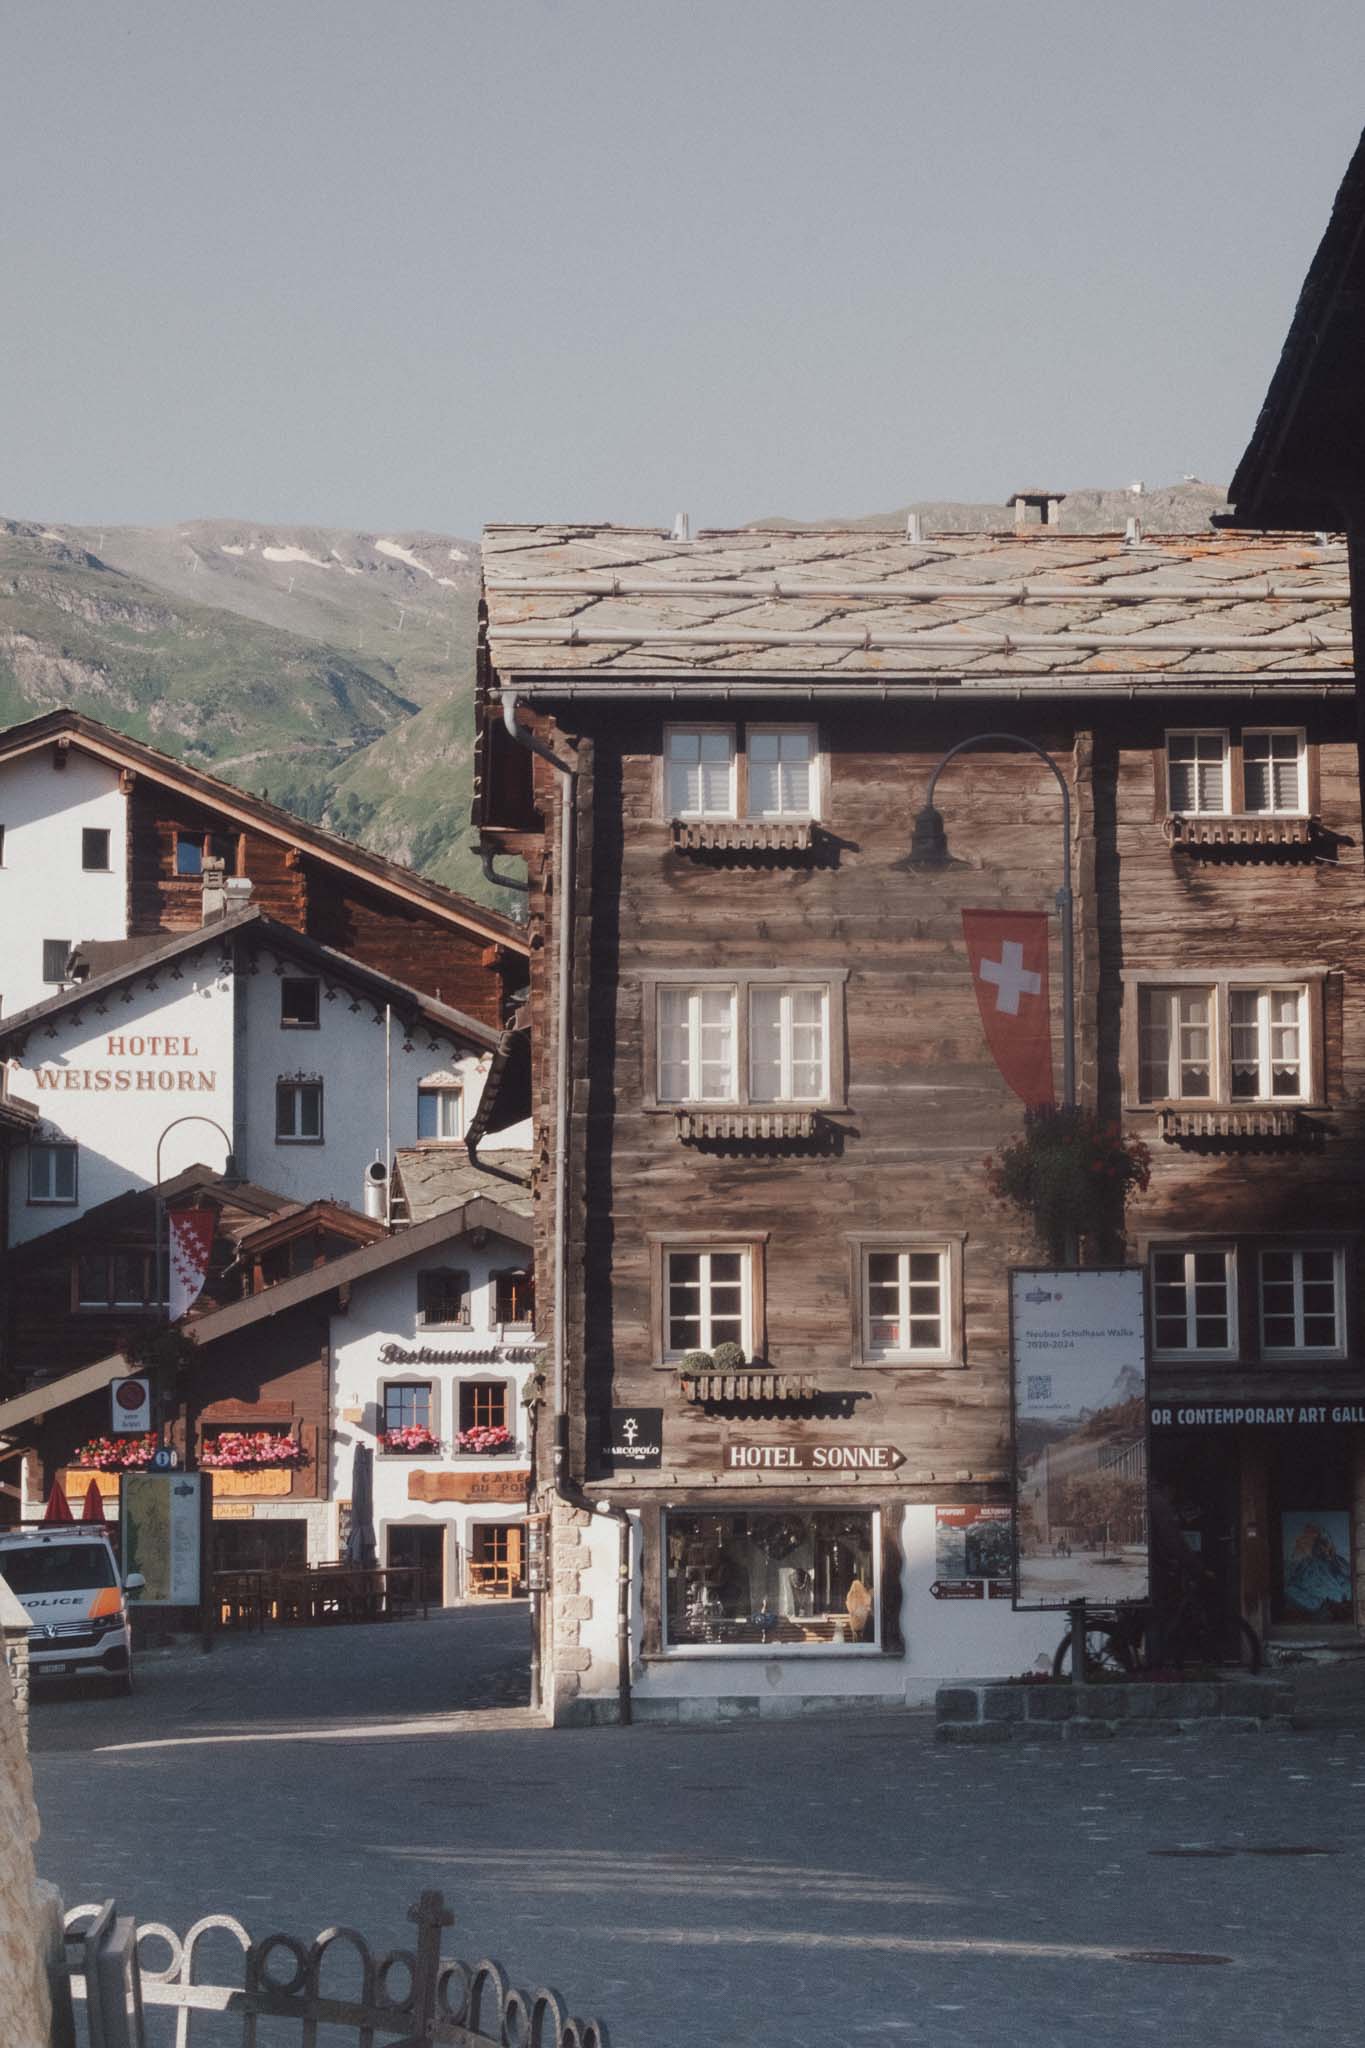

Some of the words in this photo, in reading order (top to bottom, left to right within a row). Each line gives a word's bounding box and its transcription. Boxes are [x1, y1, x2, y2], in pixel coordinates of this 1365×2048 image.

[106, 1035, 199, 1057] HOTEL
[34, 1069, 217, 1092] WEISSHORN
[1026, 1329, 1060, 1338] Neubau
[1062, 1328, 1106, 1338] Schulhaus
[377, 1342, 500, 1364] Restaurant
[1027, 1340, 1075, 1349] 2020-2024
[1151, 1408, 1172, 1425] OR
[1177, 1407, 1295, 1425] CONTEMPORARY
[1298, 1407, 1327, 1424] ART
[730, 1446, 803, 1467] HOTEL
[812, 1446, 889, 1468] SONNE
